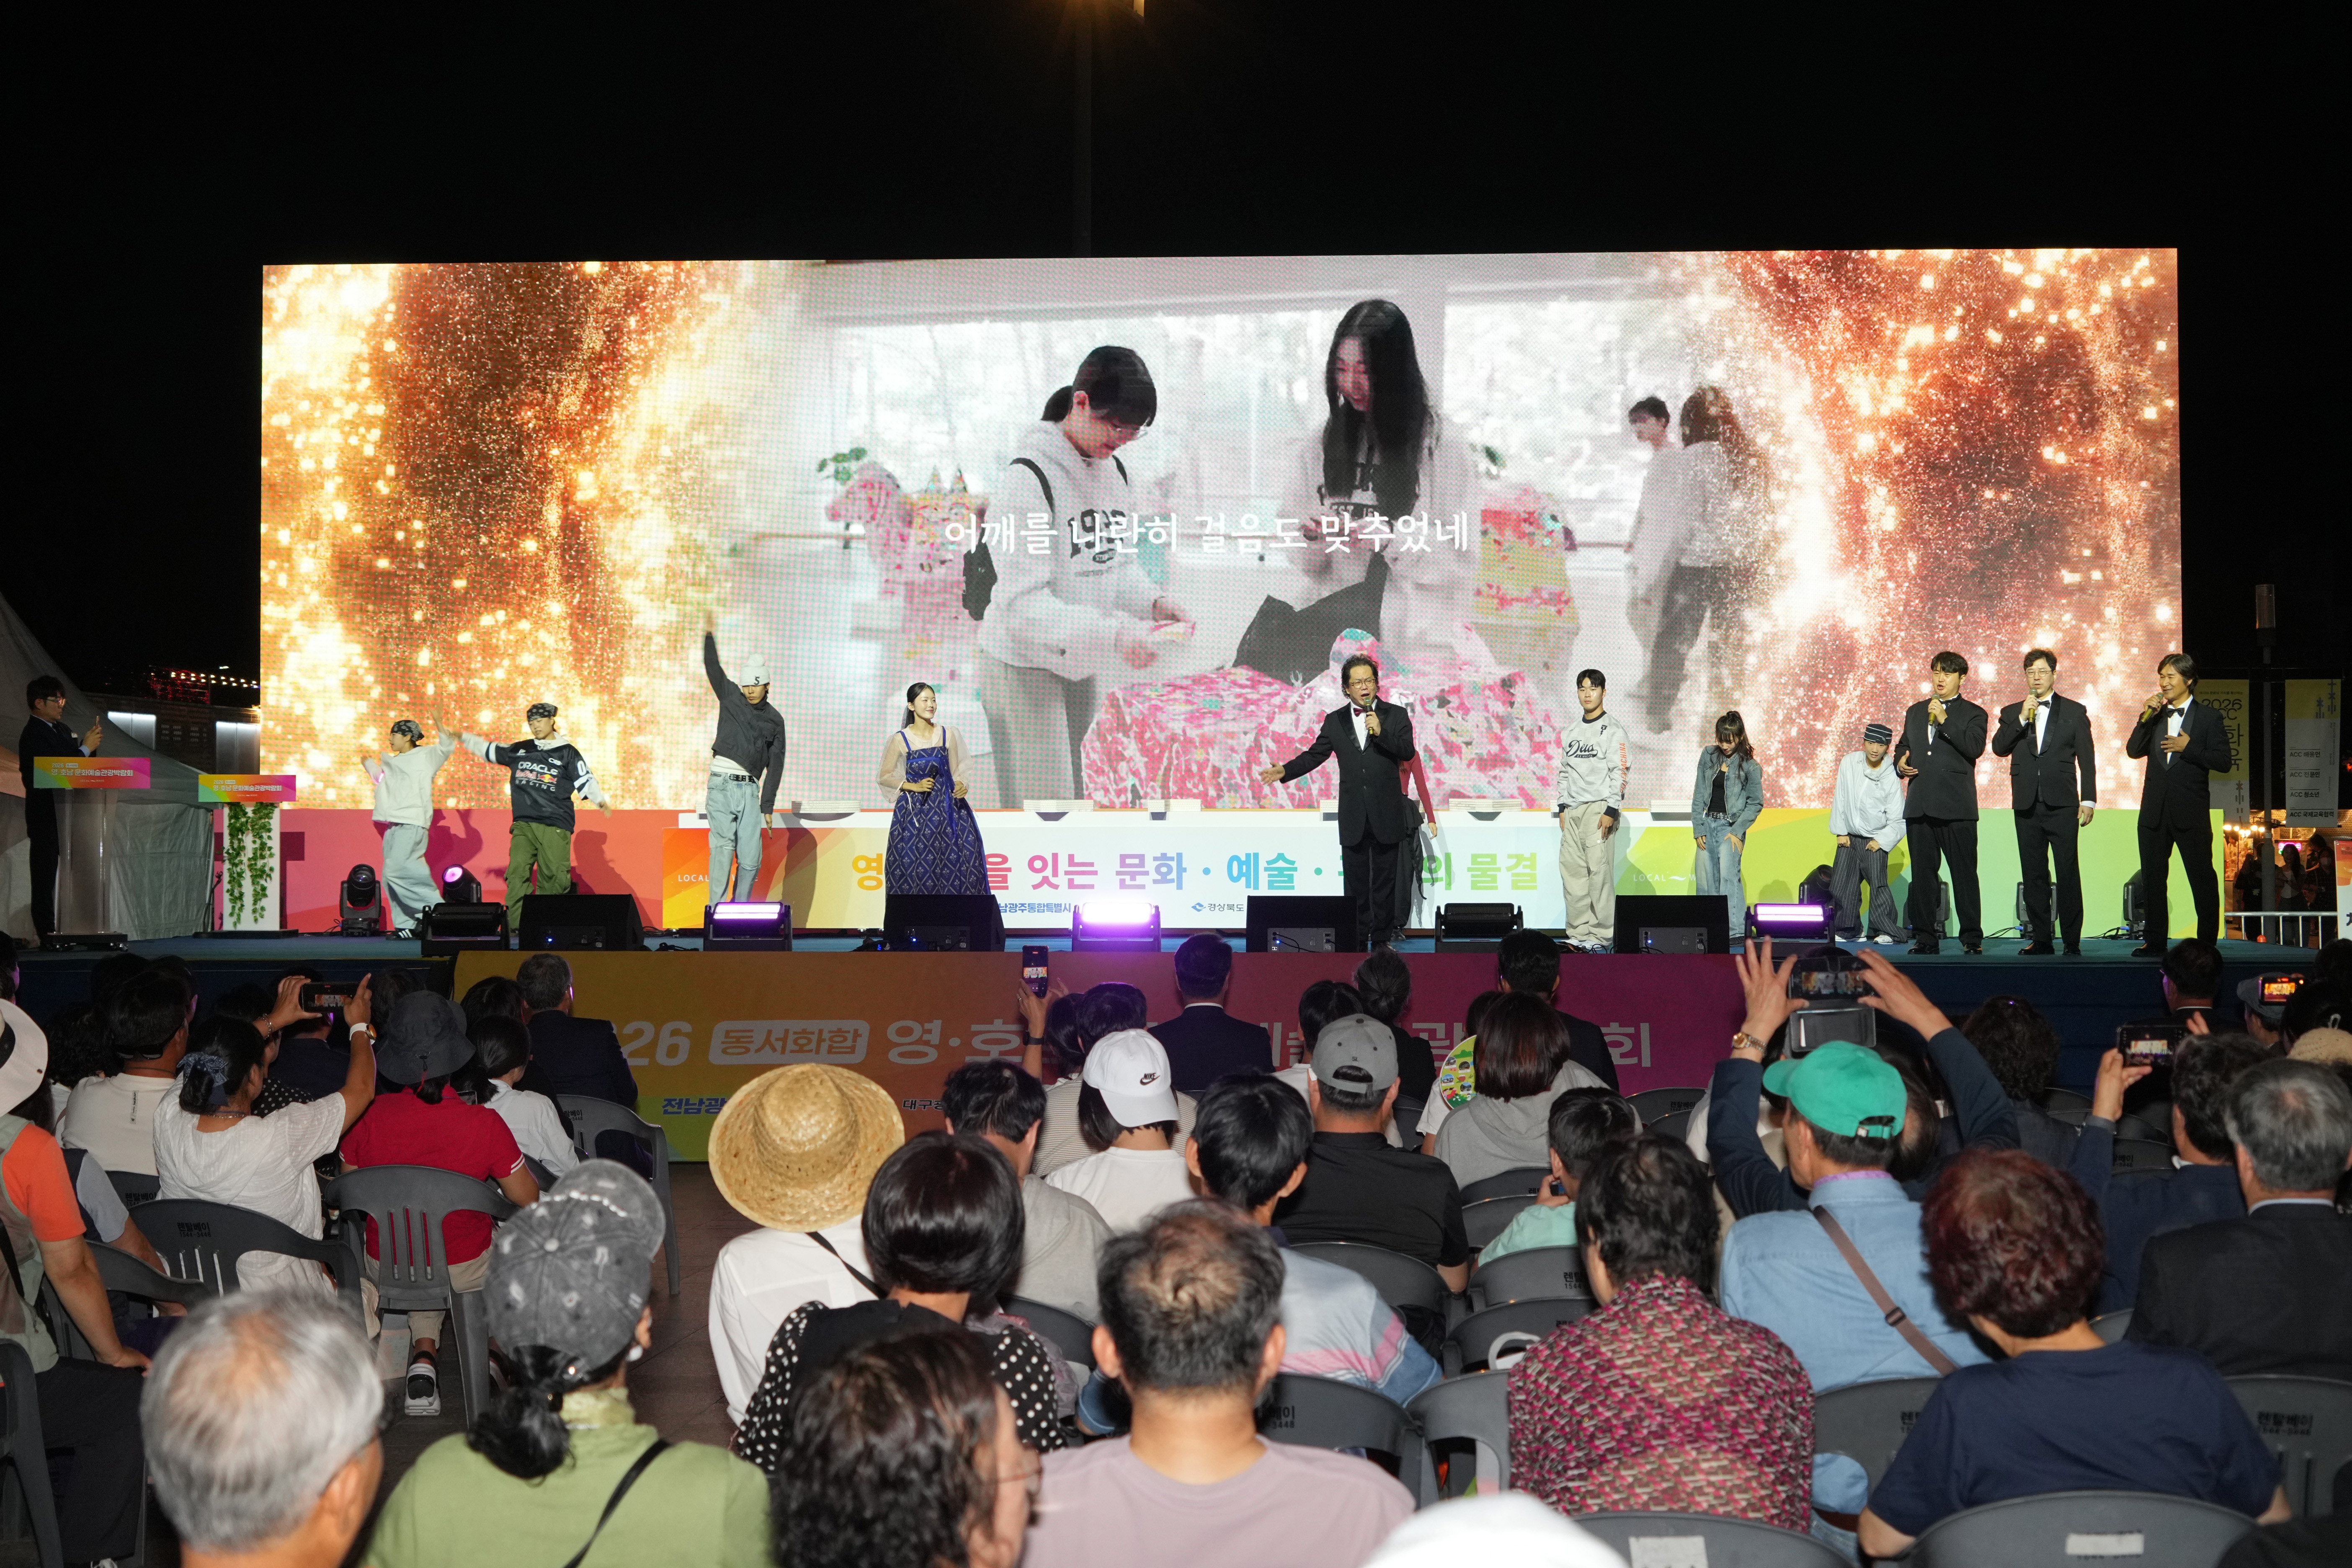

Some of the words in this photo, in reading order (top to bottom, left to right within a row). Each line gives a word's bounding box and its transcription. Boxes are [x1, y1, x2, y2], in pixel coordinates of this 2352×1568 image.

[945, 513, 1058, 554] 어깨를
[1071, 512, 1176, 553] 나란히
[1194, 512, 1307, 554] 걸음도
[1321, 511, 1467, 553] 맞추었네
[754, 676, 760, 685] S
[2202, 699, 2242, 710] 2026
[1566, 740, 1598, 757] Deus
[518, 761, 558, 775] ORACLE
[1621, 771, 1627, 780] EX
[515, 779, 555, 792] RACING
[1027, 853, 1098, 891] 잇는
[1115, 852, 1187, 890] 문화
[1227, 852, 1298, 890] 예술
[1467, 852, 1537, 890] 물결
[998, 903, 1071, 913] 남광주통합특별시
[1208, 903, 1244, 912] 경상북도
[615, 1020, 693, 1066] 26
[721, 1028, 863, 1056] 동서화합
[887, 1019, 1024, 1065] 영·호
[661, 1097, 730, 1115] 전남광
[903, 1099, 944, 1110] 대구광
[177, 1222, 210, 1232] 렌탈베이
